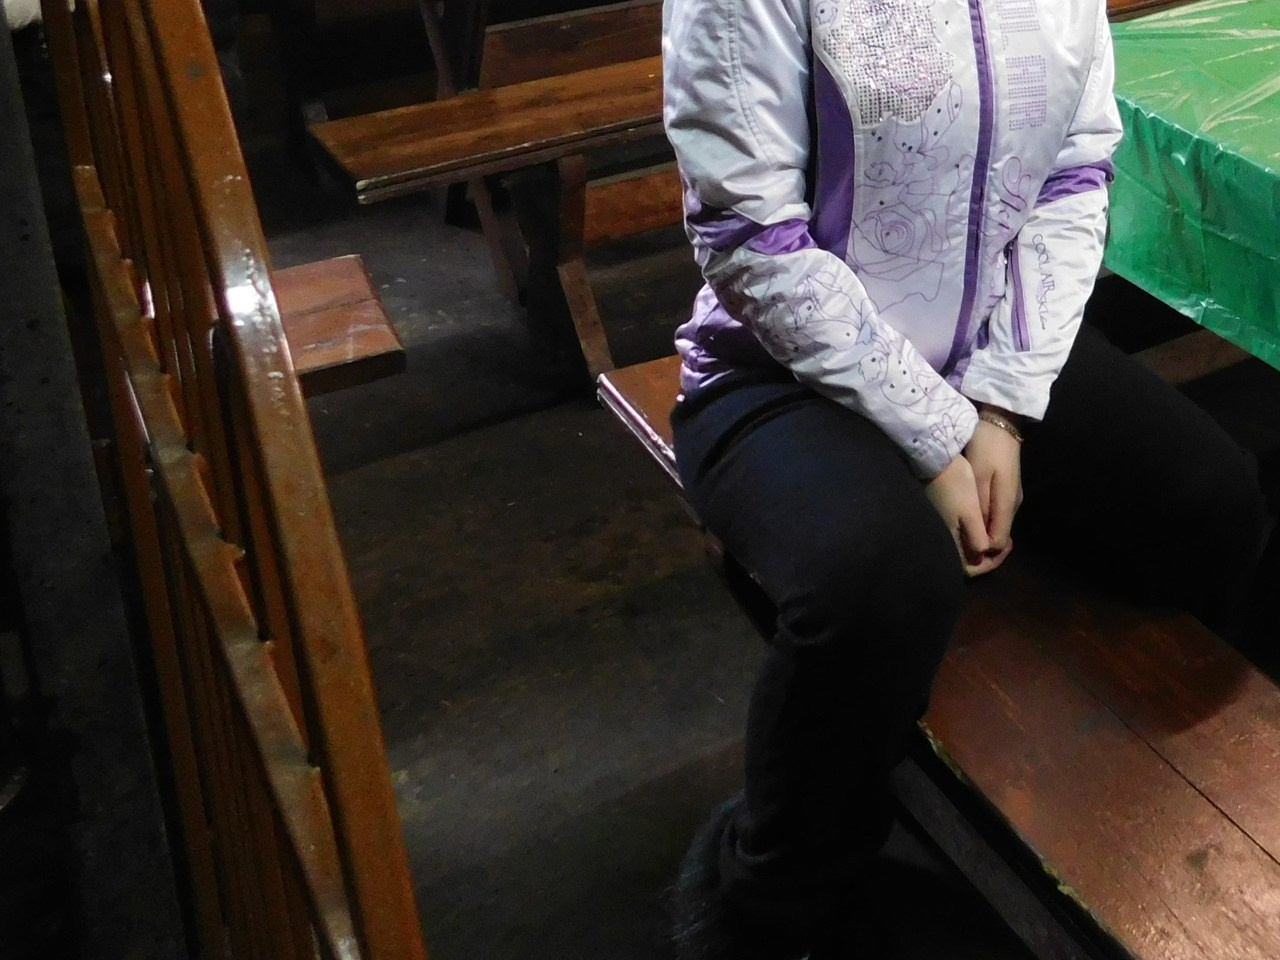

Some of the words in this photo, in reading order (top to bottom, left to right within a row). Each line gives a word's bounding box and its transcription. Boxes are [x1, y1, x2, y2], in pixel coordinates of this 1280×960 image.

[1006, 55, 1047, 131] AIR
[1032, 233, 1050, 271] COOL
[1041, 273, 1055, 296] AIR
